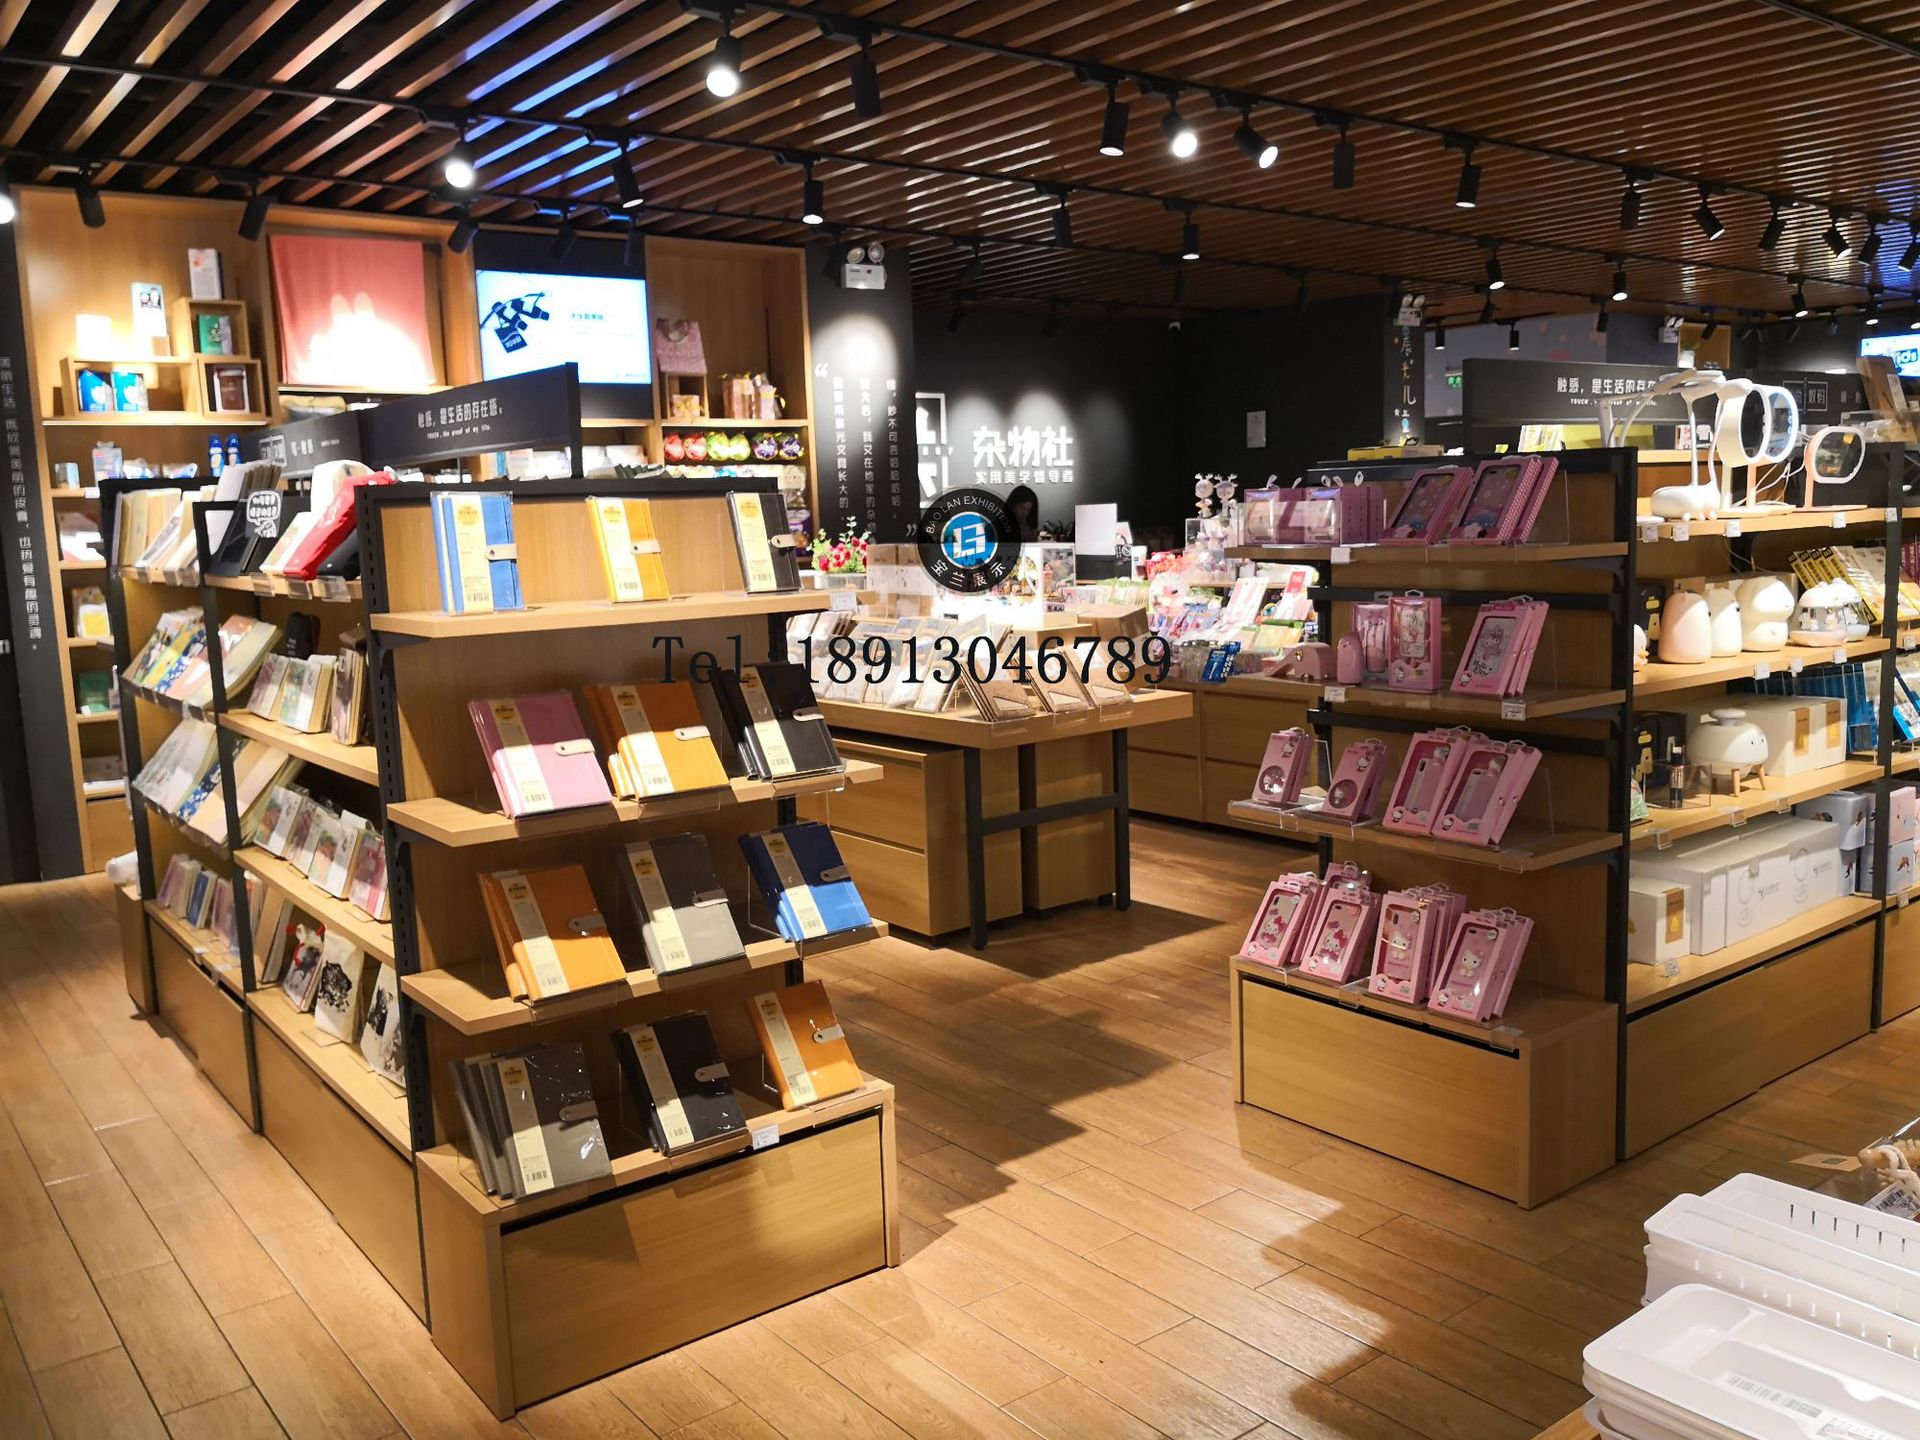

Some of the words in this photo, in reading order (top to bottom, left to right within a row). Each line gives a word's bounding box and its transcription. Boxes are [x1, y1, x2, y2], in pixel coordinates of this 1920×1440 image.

[972, 425, 1075, 467] 杂物社
[975, 469, 1074, 485] 实用美学倡导者
